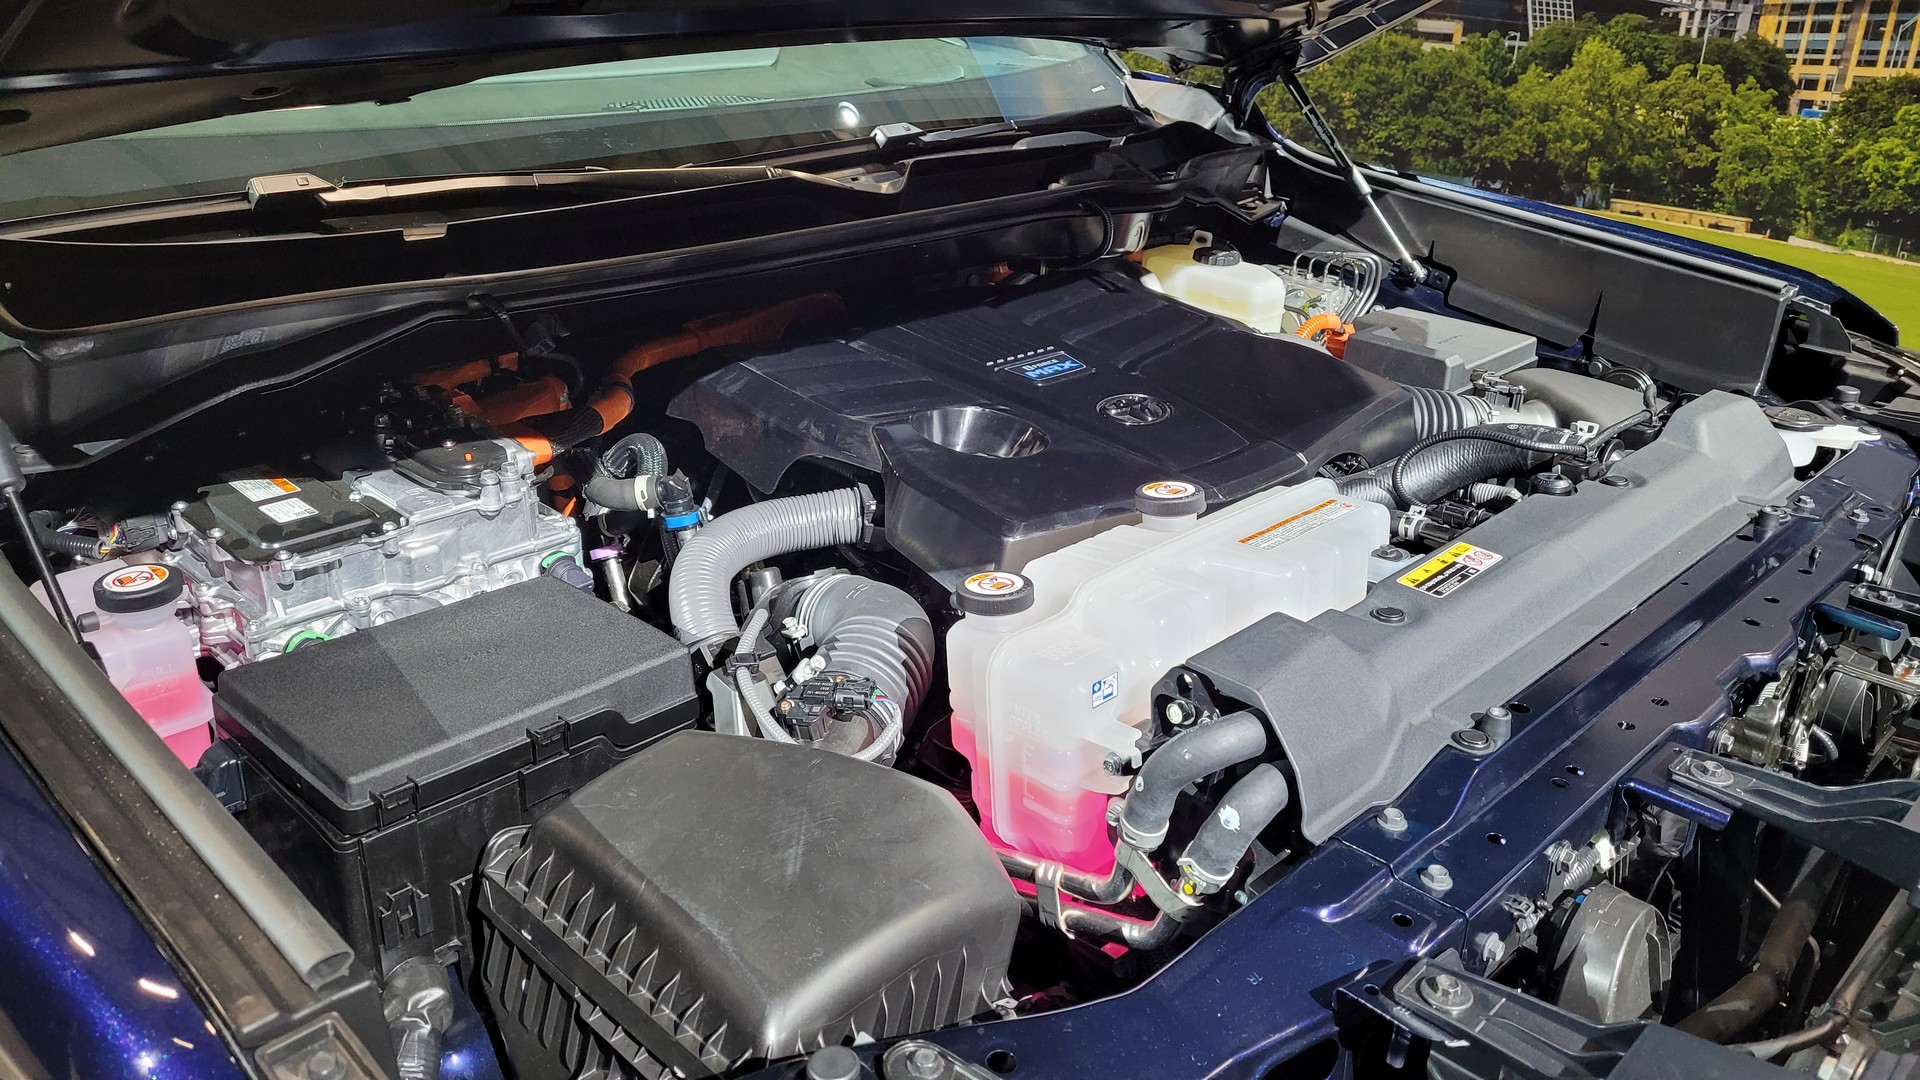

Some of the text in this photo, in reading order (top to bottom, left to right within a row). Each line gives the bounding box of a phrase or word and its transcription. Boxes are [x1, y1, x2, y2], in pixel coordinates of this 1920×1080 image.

[1024, 359, 1081, 379] MAX
[142, 663, 177, 681] FULL
[1009, 714, 1049, 741] COOLER
